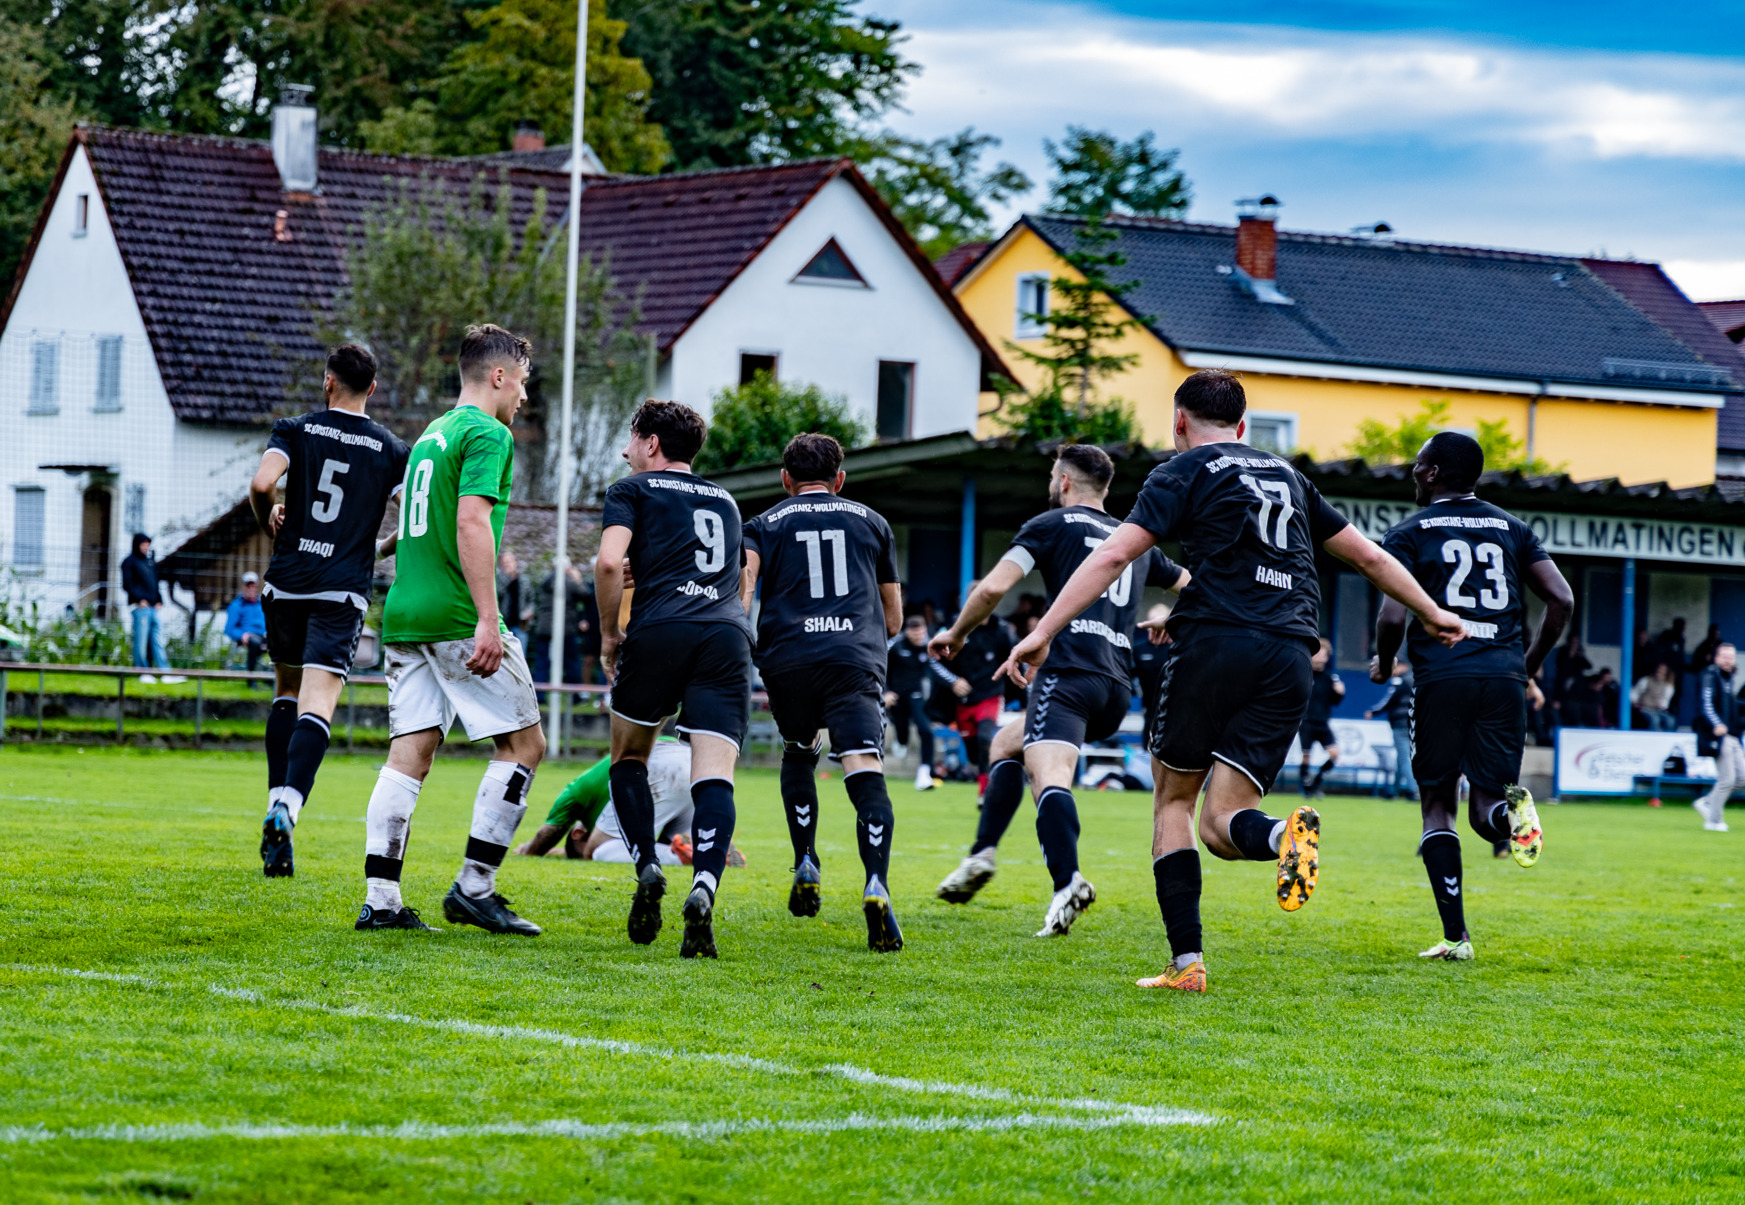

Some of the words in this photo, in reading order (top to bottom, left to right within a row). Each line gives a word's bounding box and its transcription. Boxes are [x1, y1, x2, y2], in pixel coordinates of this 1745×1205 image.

[1205, 461, 1219, 474] SC
[311, 458, 350, 523] 5
[397, 459, 434, 541] 18
[647, 479, 660, 488] SC
[659, 479, 738, 508] KONSTANZ-WOLLMATI
[767, 512, 778, 523] SC
[777, 502, 867, 518] KONSTANZ-WOLLMATINGEN
[1238, 474, 1294, 550] 17
[1419, 518, 1431, 529] SC
[1430, 516, 1509, 531] KONSTANZ-WOLLMATINGEN
[298, 537, 335, 558] THAQI
[693, 509, 726, 573] 9
[1522, 513, 1735, 557] OLLMATINGEN
[795, 529, 849, 598] 11
[1255, 565, 1292, 590] HAHN
[1441, 539, 1509, 610] 23
[804, 616, 853, 632] SHALA
